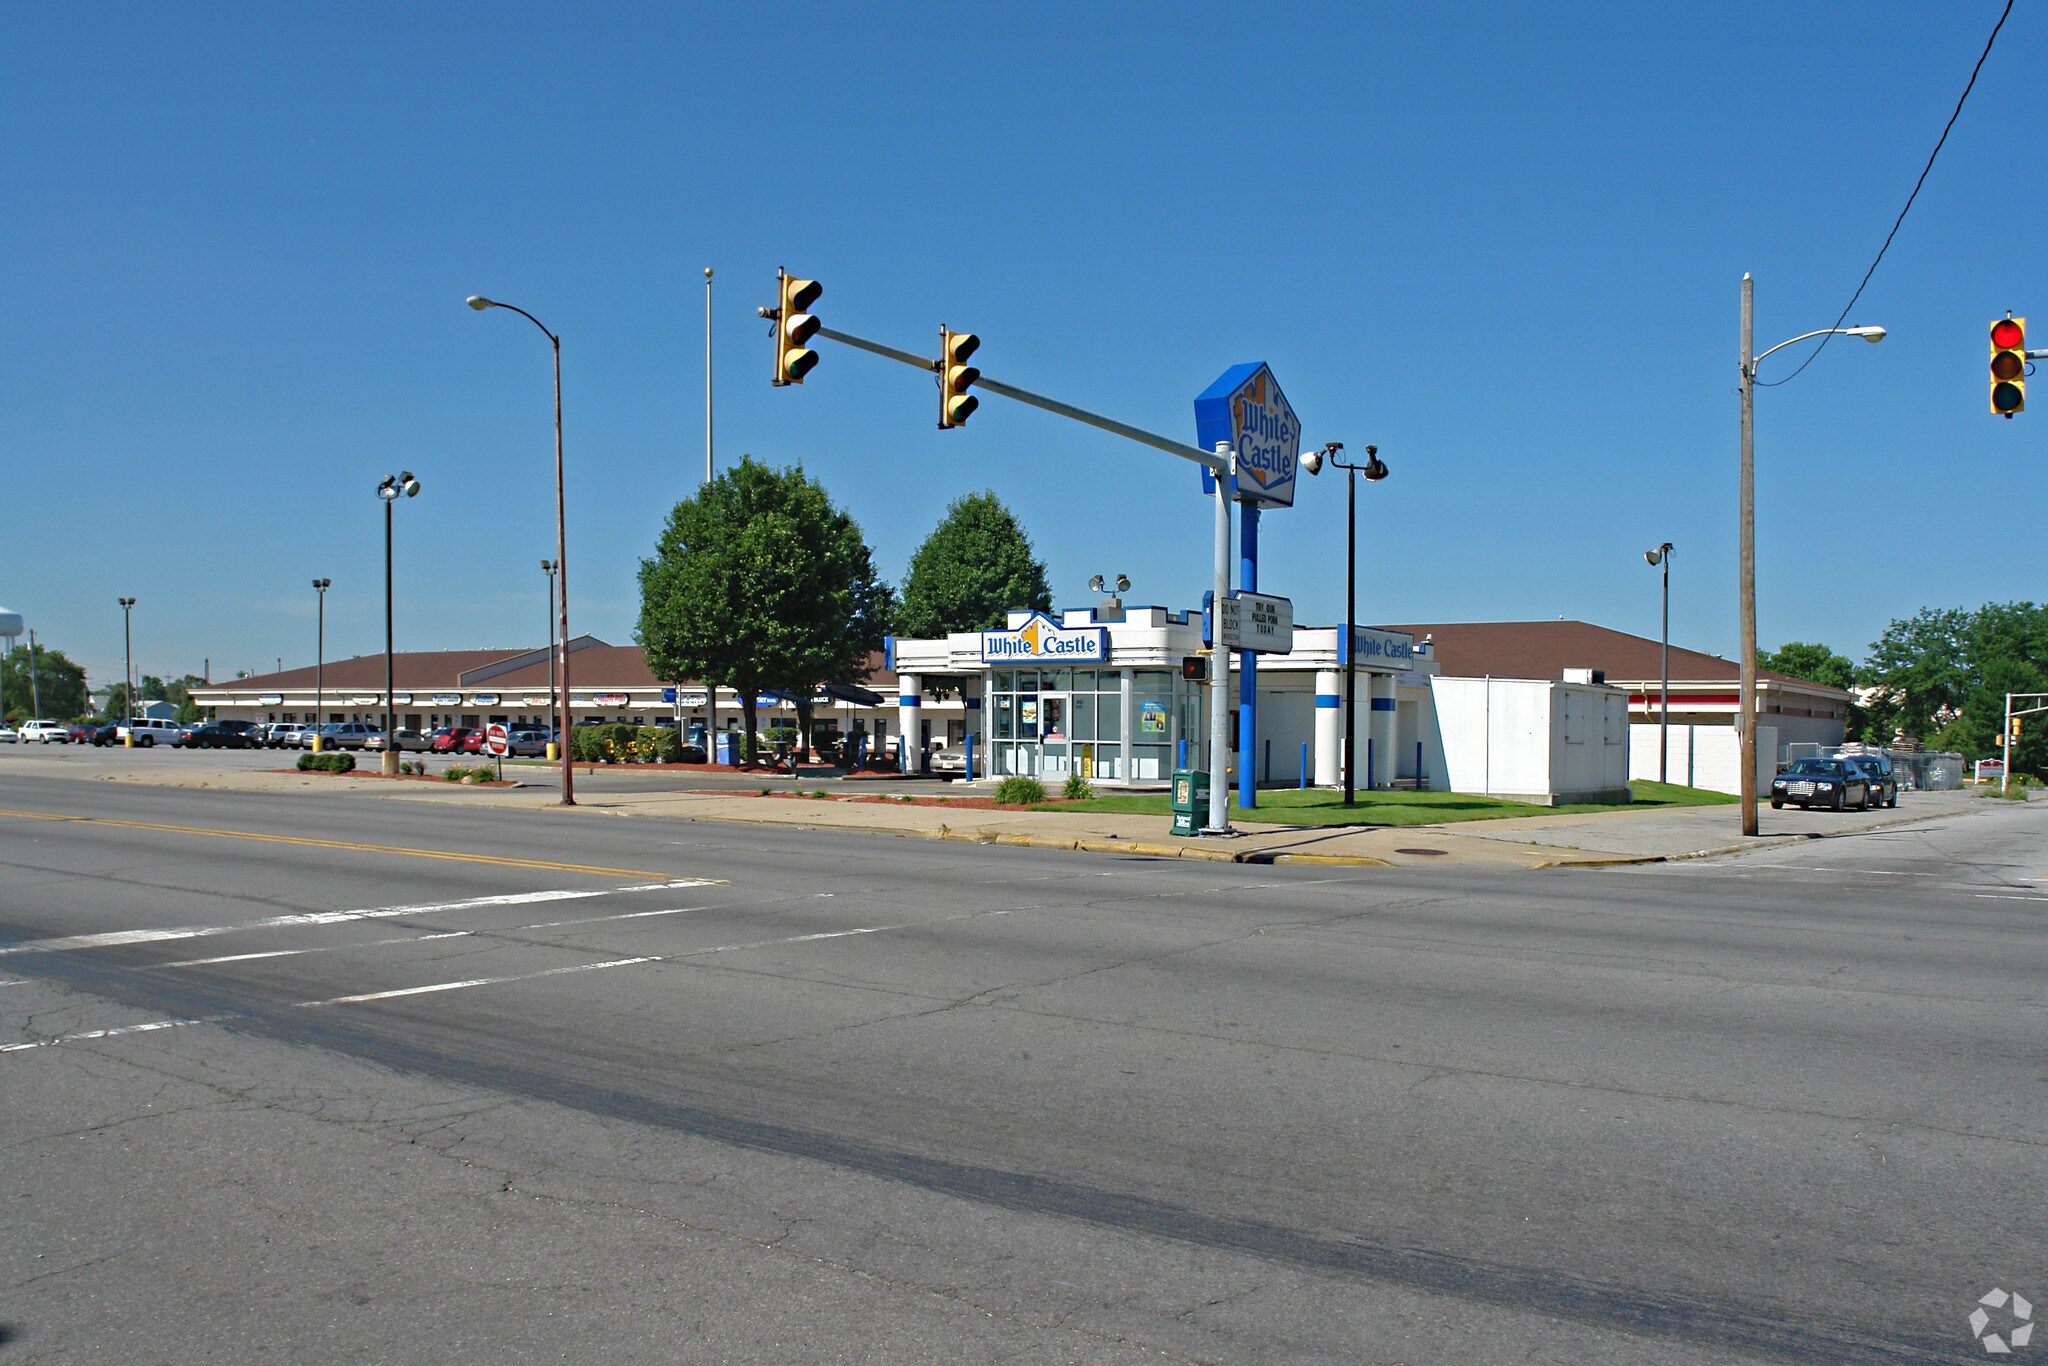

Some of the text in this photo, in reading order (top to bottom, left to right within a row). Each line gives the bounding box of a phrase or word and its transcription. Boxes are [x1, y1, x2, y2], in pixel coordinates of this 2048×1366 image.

[1242, 400, 1289, 443] White
[1238, 434, 1291, 476] Castle
[1222, 604, 1240, 615] DO NOT
[1256, 602, 1275, 613] TRY OUR
[1223, 618, 1238, 630] BLOCK
[1252, 612, 1279, 625] PULLED PORK
[1256, 624, 1274, 635] TODAY
[987, 635, 1096, 657] White Castle
[1354, 634, 1413, 659] White Castle
